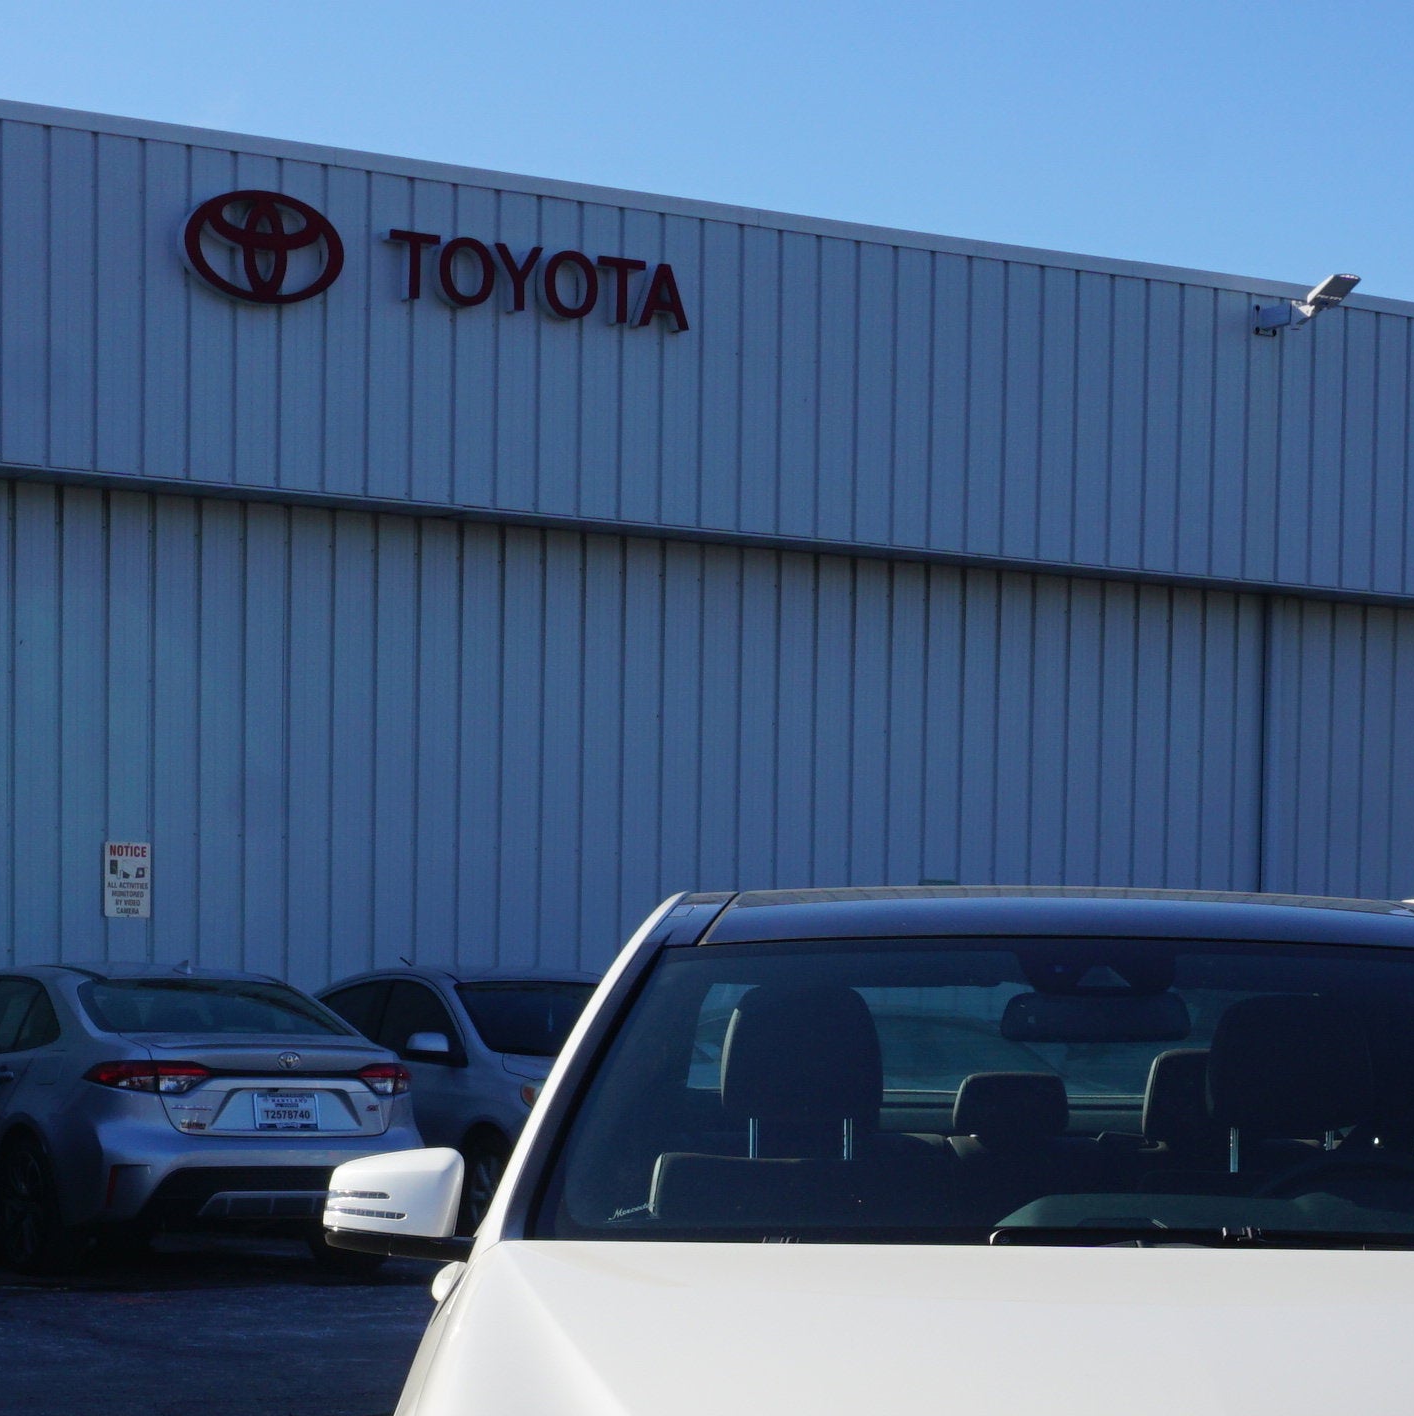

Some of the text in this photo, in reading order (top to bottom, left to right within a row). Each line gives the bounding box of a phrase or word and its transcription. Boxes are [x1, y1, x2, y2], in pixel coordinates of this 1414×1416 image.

[388, 229, 689, 332] TOYOTA
[109, 844, 147, 858] NOTICE
[116, 907, 139, 915] CAMERA
[264, 1110, 311, 1120] T2578740
